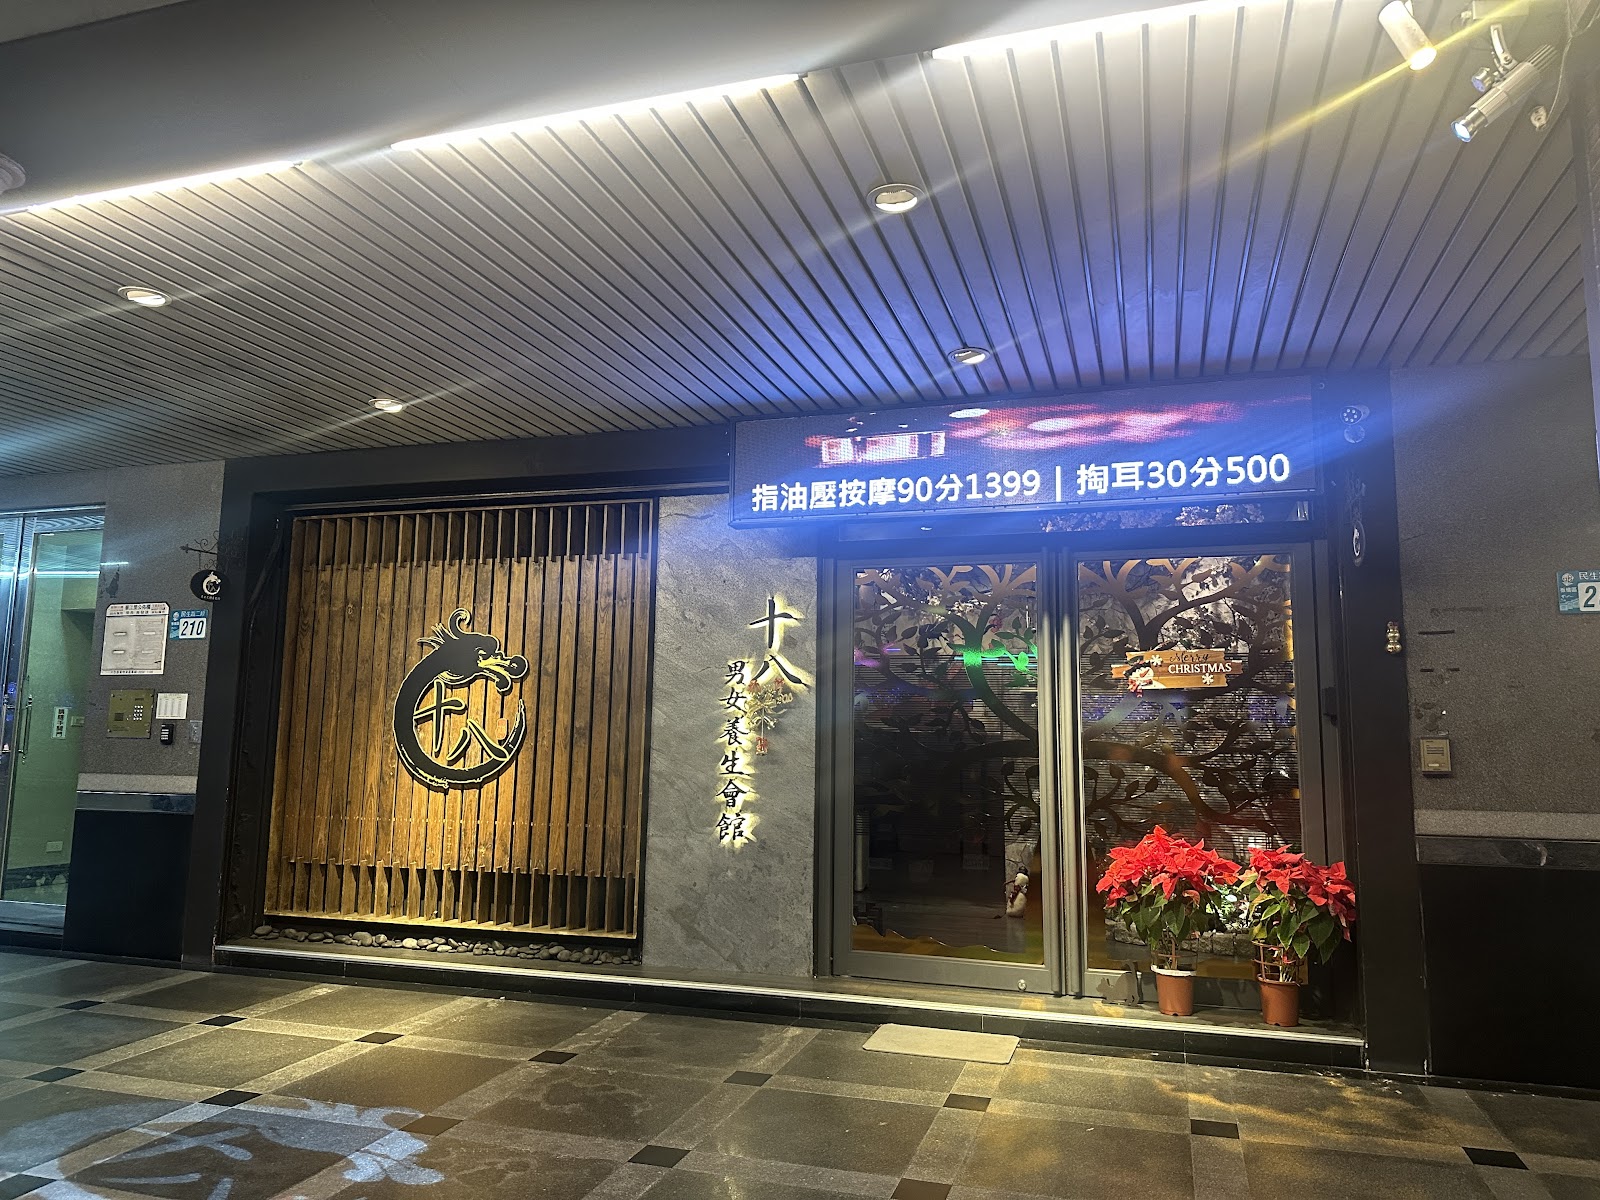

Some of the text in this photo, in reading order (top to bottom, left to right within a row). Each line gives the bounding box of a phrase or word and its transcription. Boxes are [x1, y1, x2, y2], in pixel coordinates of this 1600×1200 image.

[752, 469, 1041, 512] 指油壓按摩90分1399
[1076, 453, 1290, 496] 掏耳30分500
[1579, 571, 1600, 580] 民生
[1583, 585, 1600, 608] 2
[181, 620, 204, 636] 210
[748, 596, 811, 693] 十八
[1168, 662, 1233, 674] CHRISTMAS
[1169, 652, 1211, 663] Merry
[412, 679, 510, 761] 十八
[716, 660, 754, 842] 男女養生會館
